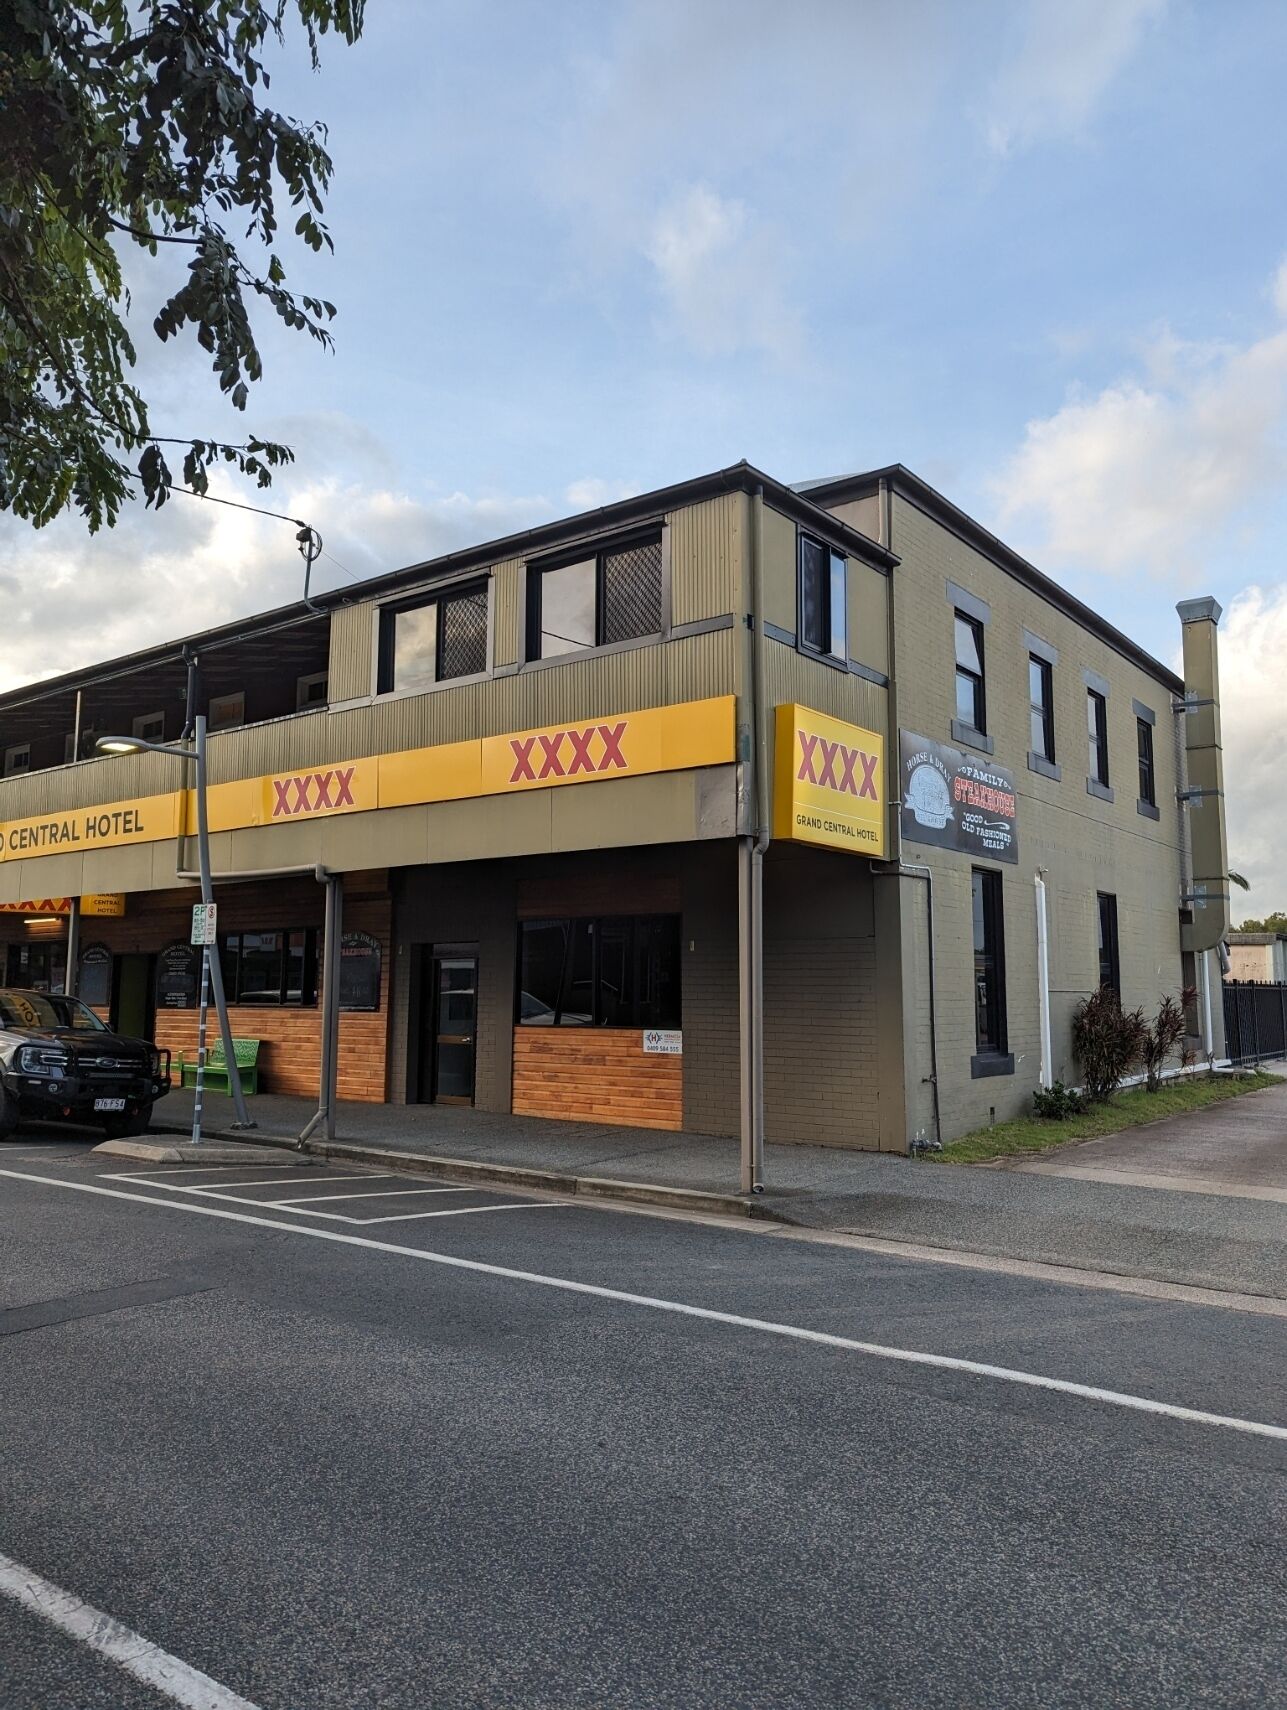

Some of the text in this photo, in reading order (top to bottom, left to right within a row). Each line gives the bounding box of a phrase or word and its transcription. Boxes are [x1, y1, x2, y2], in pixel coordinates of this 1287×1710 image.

[509, 722, 628, 784] XXXX
[797, 730, 879, 801] XXXX
[906, 752, 928, 772] HORSE
[935, 757, 952, 783] DRAY
[272, 766, 356, 818] XXXX
[966, 766, 1004, 786] FAMILY
[954, 776, 1015, 818] STEAKHOUSE
[9, 819, 80, 851] CENTRAL
[86, 809, 144, 839] HOTEL
[796, 814, 879, 842] GRAND CENTRAL HOTEL
[961, 821, 1012, 843] OLD FASHIONED
[194, 905, 206, 916] 2P
